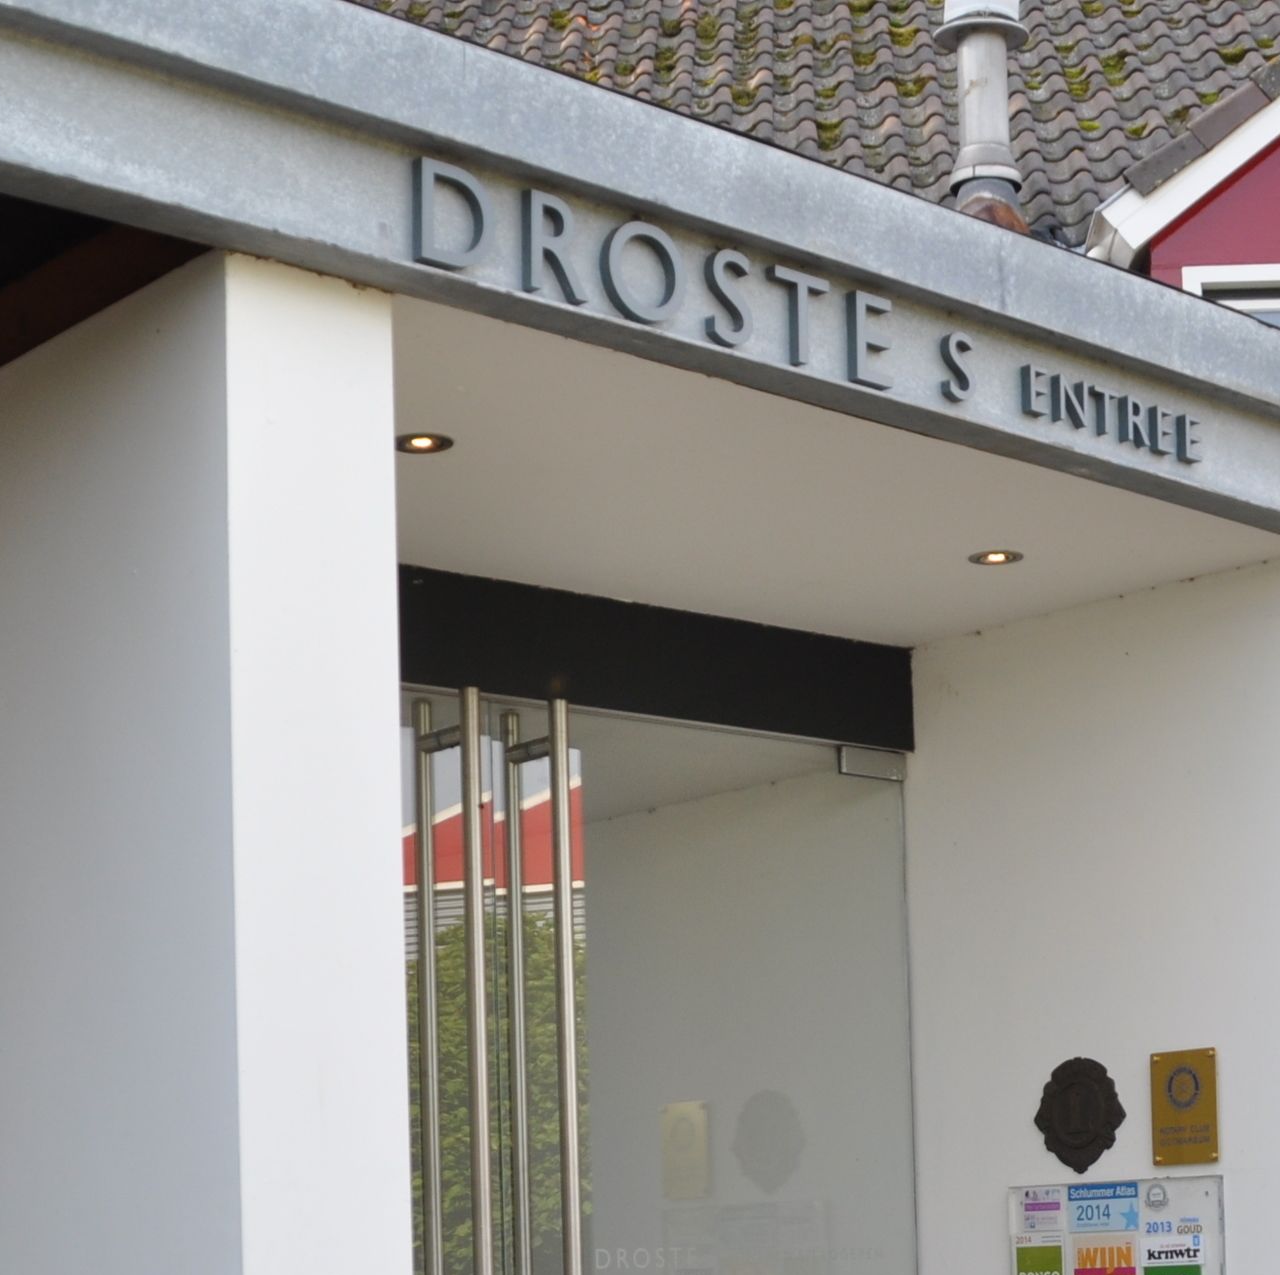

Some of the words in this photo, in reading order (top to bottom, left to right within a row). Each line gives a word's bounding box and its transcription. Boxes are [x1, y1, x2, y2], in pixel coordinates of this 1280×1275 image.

[412, 155, 892, 390] DROSTE
[1020, 364, 1201, 464] ENTREE
[1070, 1187, 1114, 1199] Schlummer
[1115, 1185, 1136, 1197] Atlas
[1076, 1203, 1111, 1221] 2014
[1146, 1221, 1172, 1233] 2013
[1177, 1224, 1202, 1234] GOUD
[1016, 1236, 1032, 1244] 2014
[1077, 1246, 1132, 1275] WIJN
